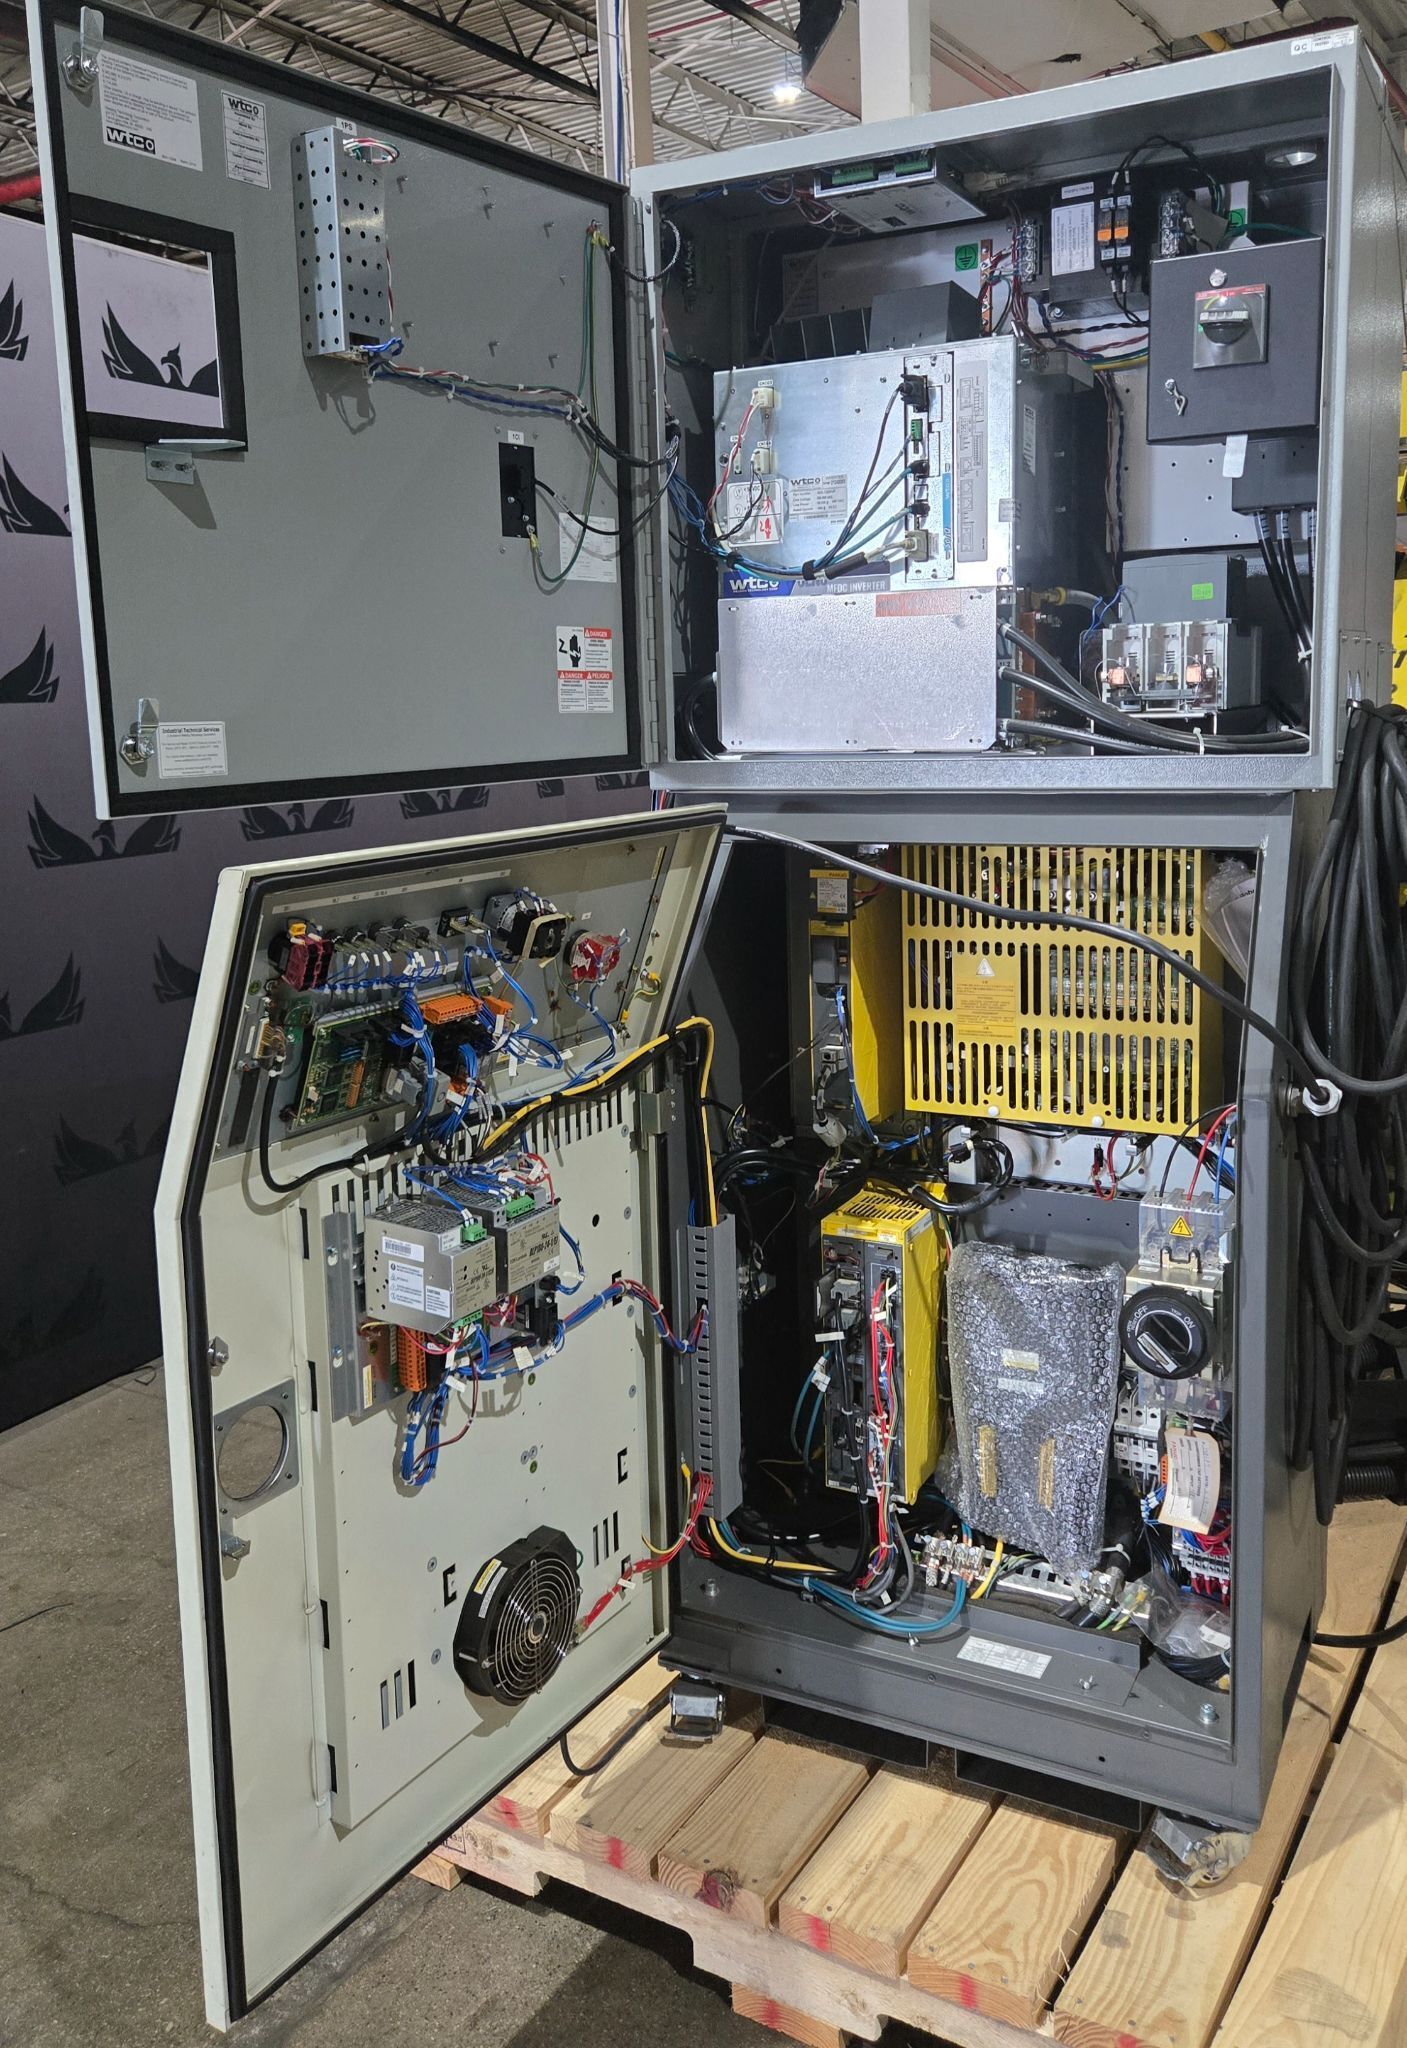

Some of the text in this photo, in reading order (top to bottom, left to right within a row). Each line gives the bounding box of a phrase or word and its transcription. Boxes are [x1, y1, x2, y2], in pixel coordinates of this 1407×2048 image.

[228, 98, 259, 116] wtco
[341, 122, 353, 131] 1PS
[106, 126, 155, 152] wtco
[790, 478, 820, 486] wtco
[729, 576, 779, 590] wtco
[826, 580, 886, 593] MFDC INVERTER
[1134, 1306, 1148, 1319] OFF
[1184, 1316, 1196, 1329] ON
